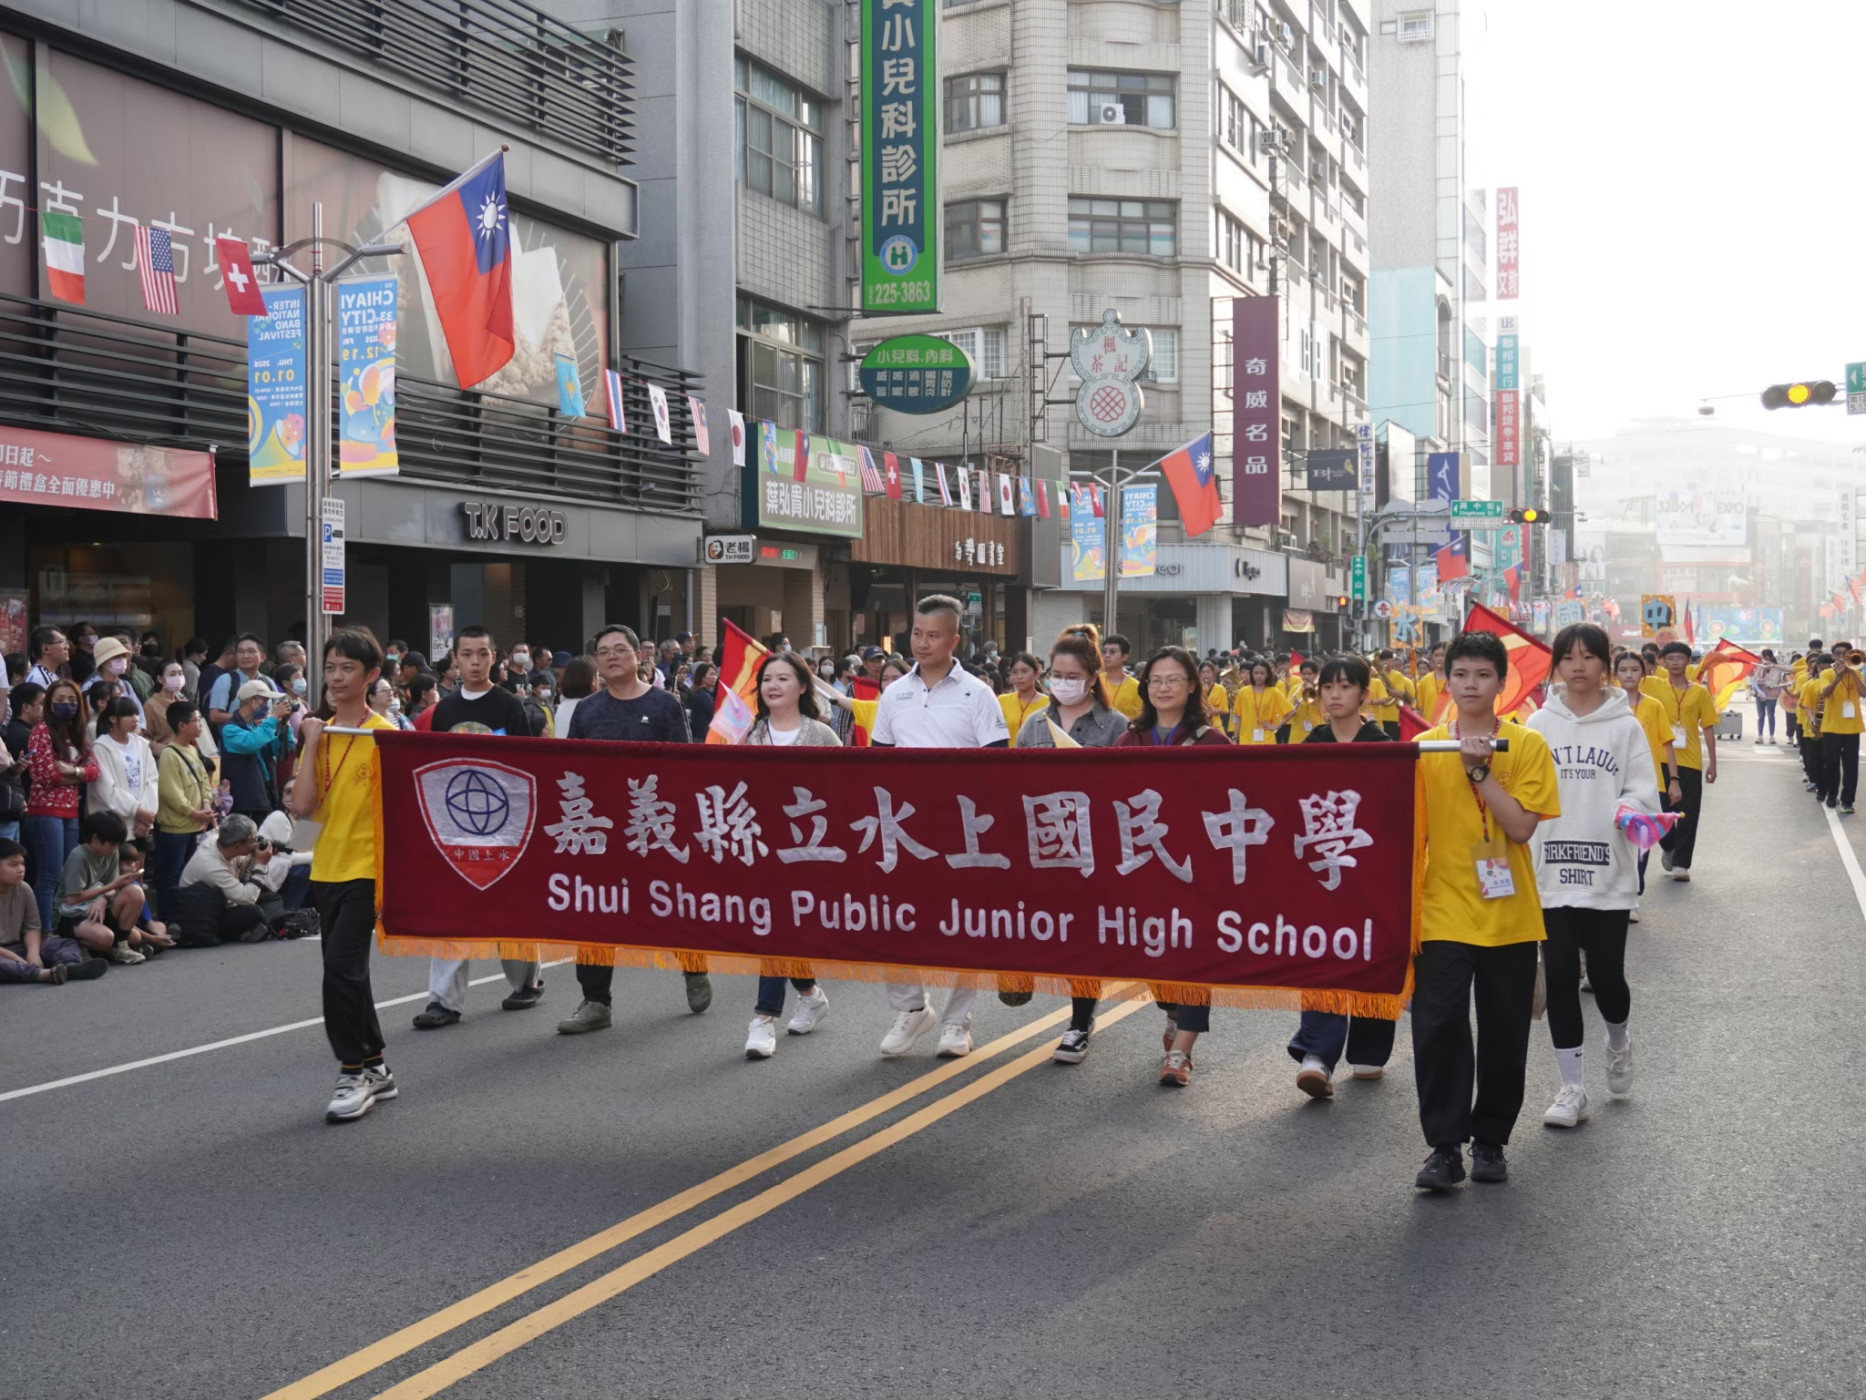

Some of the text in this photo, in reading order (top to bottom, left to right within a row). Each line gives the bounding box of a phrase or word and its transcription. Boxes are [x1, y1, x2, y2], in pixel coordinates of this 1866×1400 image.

[881, 0, 917, 227] 小兒科診所
[875, 281, 931, 304] 225-3863
[1245, 357, 1268, 475] 奇威名品
[503, 505, 568, 545] FOOD
[1717, 502, 1744, 514] EXPO
[1643, 598, 1668, 632] 中
[1574, 769, 1596, 779] YOUR
[543, 770, 1374, 891] 嘉義縣立水上國民中學
[1560, 868, 1595, 886] SHIRT
[547, 873, 1372, 961] Shui Shang Public Junior High School
